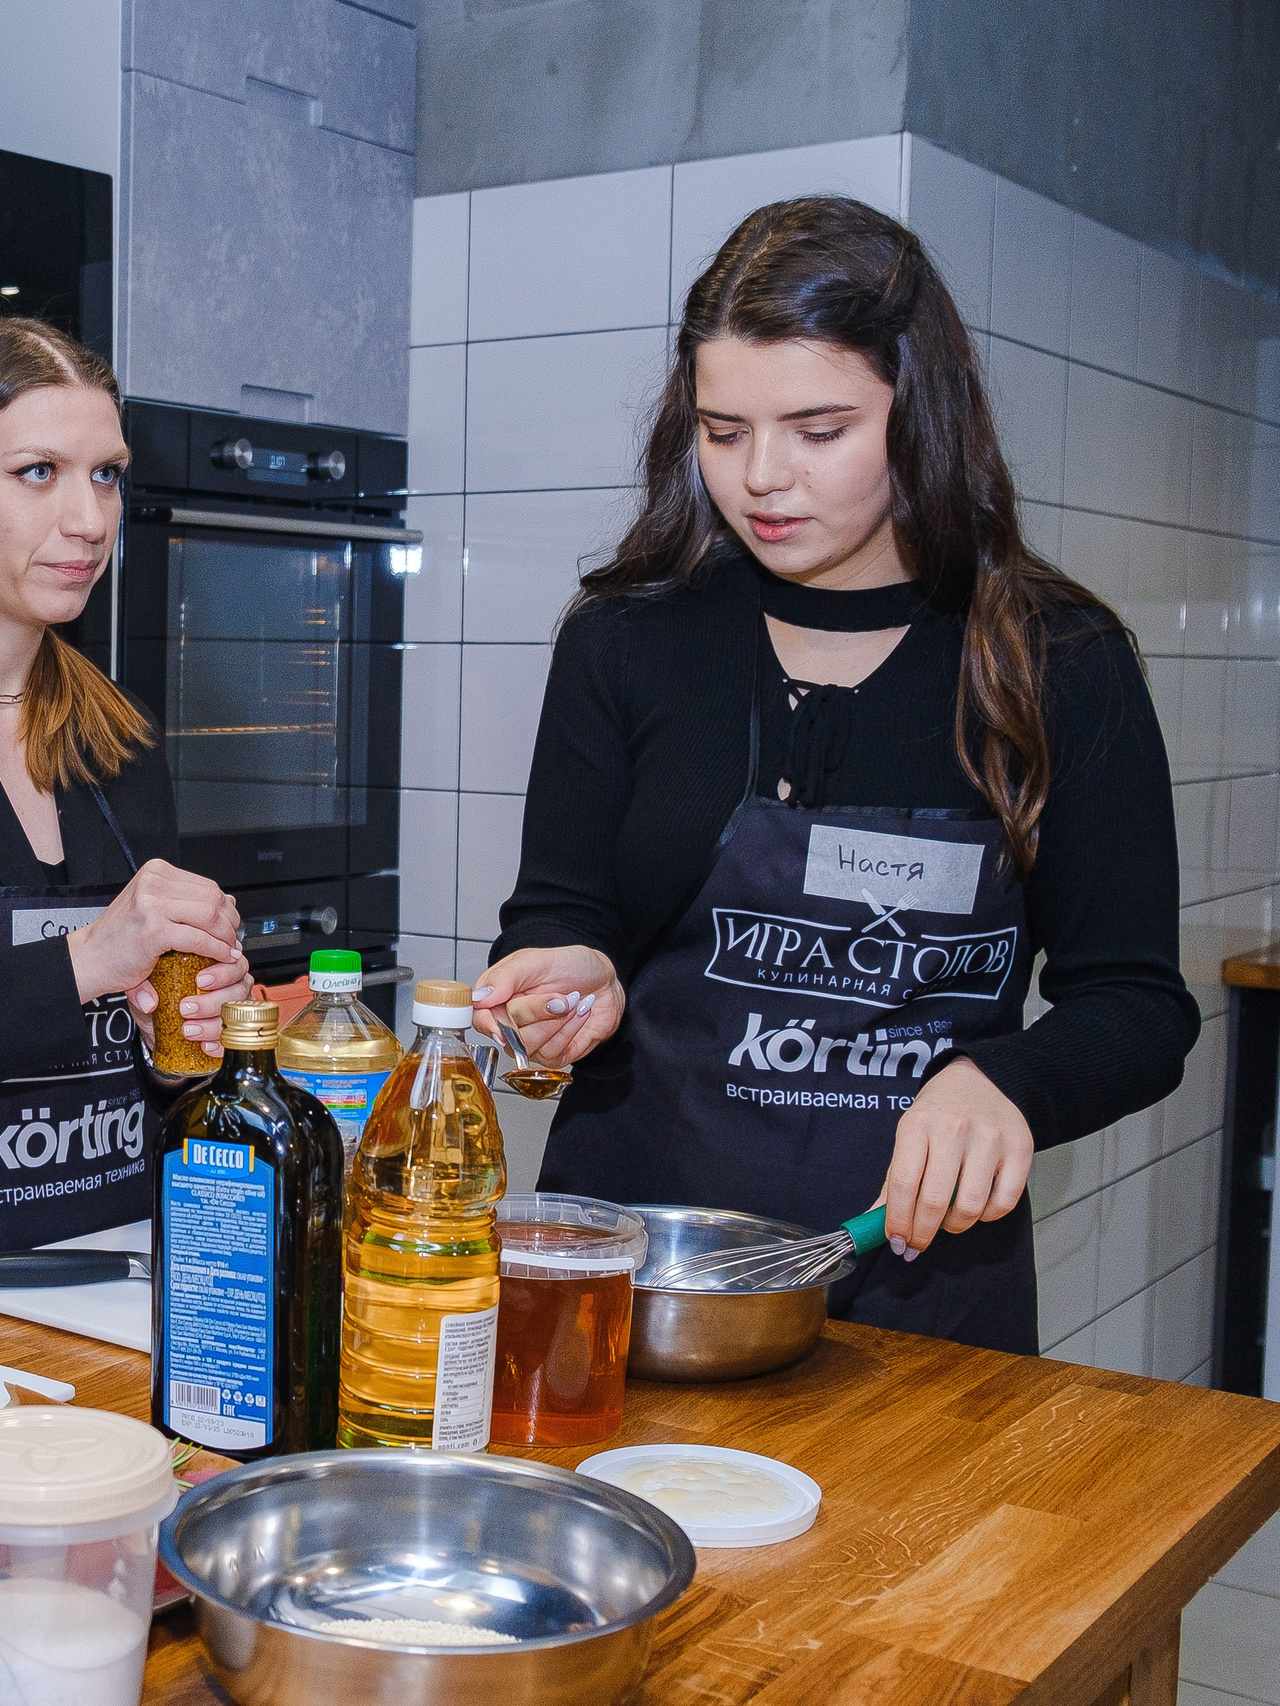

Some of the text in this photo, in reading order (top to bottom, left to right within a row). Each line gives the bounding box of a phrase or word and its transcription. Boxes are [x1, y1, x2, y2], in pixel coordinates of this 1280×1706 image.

[837, 844, 925, 882] Настя
[725, 916, 1010, 984] ИГРА СТОЛОВ
[757, 968, 892, 997] КУЛИНАРНАЯ
[726, 1084, 879, 1110] встраиваемая
[209, 1145, 245, 1169] CECCO
[106, 1159, 145, 1184] техника
